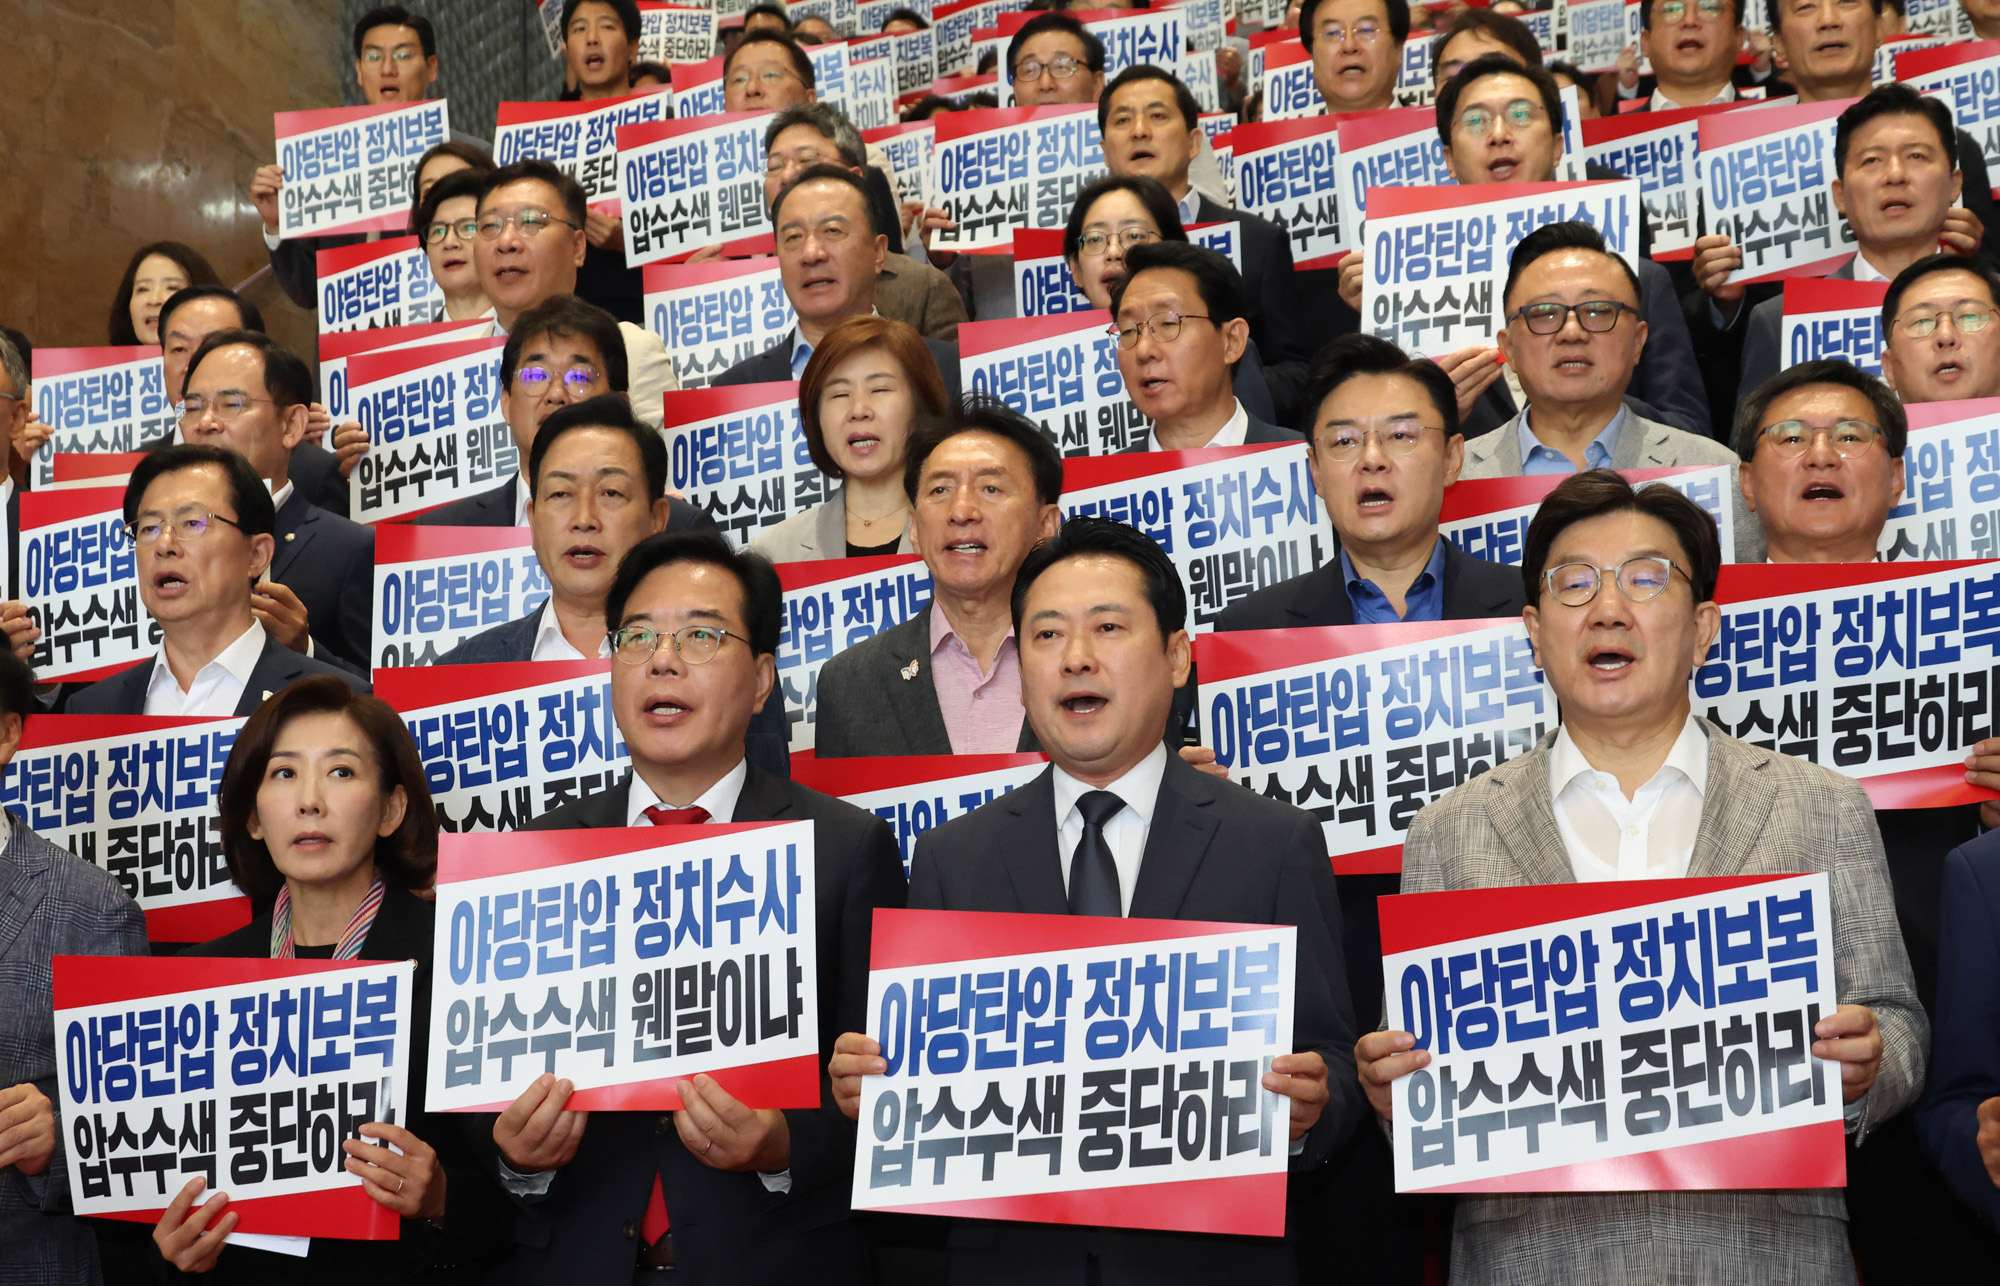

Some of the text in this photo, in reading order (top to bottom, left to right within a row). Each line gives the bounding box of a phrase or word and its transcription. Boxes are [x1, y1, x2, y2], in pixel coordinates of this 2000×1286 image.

[664, 37, 711, 60] 중단하라
[665, 12, 712, 36] 정치보복
[937, 34, 973, 73] 압수수
[1095, 20, 1180, 74] 정치수사
[1572, 2, 1625, 36] 야당탄압
[282, 106, 444, 183] 야당탄압 정치보복
[625, 127, 767, 203] 야당탄압 정치
[941, 132, 1031, 194] 야당탄압
[1241, 138, 1337, 209] 야당탄압
[1710, 129, 1826, 211] 야당탄압
[284, 165, 363, 230] 압수수색
[629, 179, 775, 256] 압수수색 웬말
[939, 183, 1030, 243] 압수수색
[324, 258, 402, 326] 야당탄압
[407, 252, 440, 300] 정
[1374, 214, 1497, 287] 야당탄압
[654, 277, 799, 350] 야당탄압 정
[1372, 279, 1494, 347] 압수수색
[39, 363, 173, 430] 야당탄압 정
[358, 370, 457, 447] 야당탄압
[971, 334, 1128, 416] 야당탄압 정
[358, 432, 459, 513] 압수수색
[672, 409, 785, 491] 야당탄압
[1182, 457, 1318, 549] 정치수사
[26, 517, 136, 599] 야당탄압
[382, 557, 513, 636] 야당탄압
[25, 584, 139, 670] 압수수색
[1688, 573, 2000, 700] 당탄압 정치보복
[408, 699, 530, 795] 당탄압
[538, 682, 633, 774] 정치
[1211, 635, 1546, 770] 야당탄압 정치보복
[448, 842, 802, 987] 야당탄압 정치수사
[879, 942, 1281, 1079] 야당탄압 정치보복
[1400, 888, 1819, 1056] 야당탄압 정치보복
[65, 974, 398, 1105] 야당탄압 정치보복
[444, 946, 804, 1090] 압수수색 웬말이냐
[868, 1054, 1280, 1191] 압수수색 중단하라
[1406, 1002, 1828, 1172] 압수수색 중단하라
[72, 1098, 217, 1200] 압수수색
